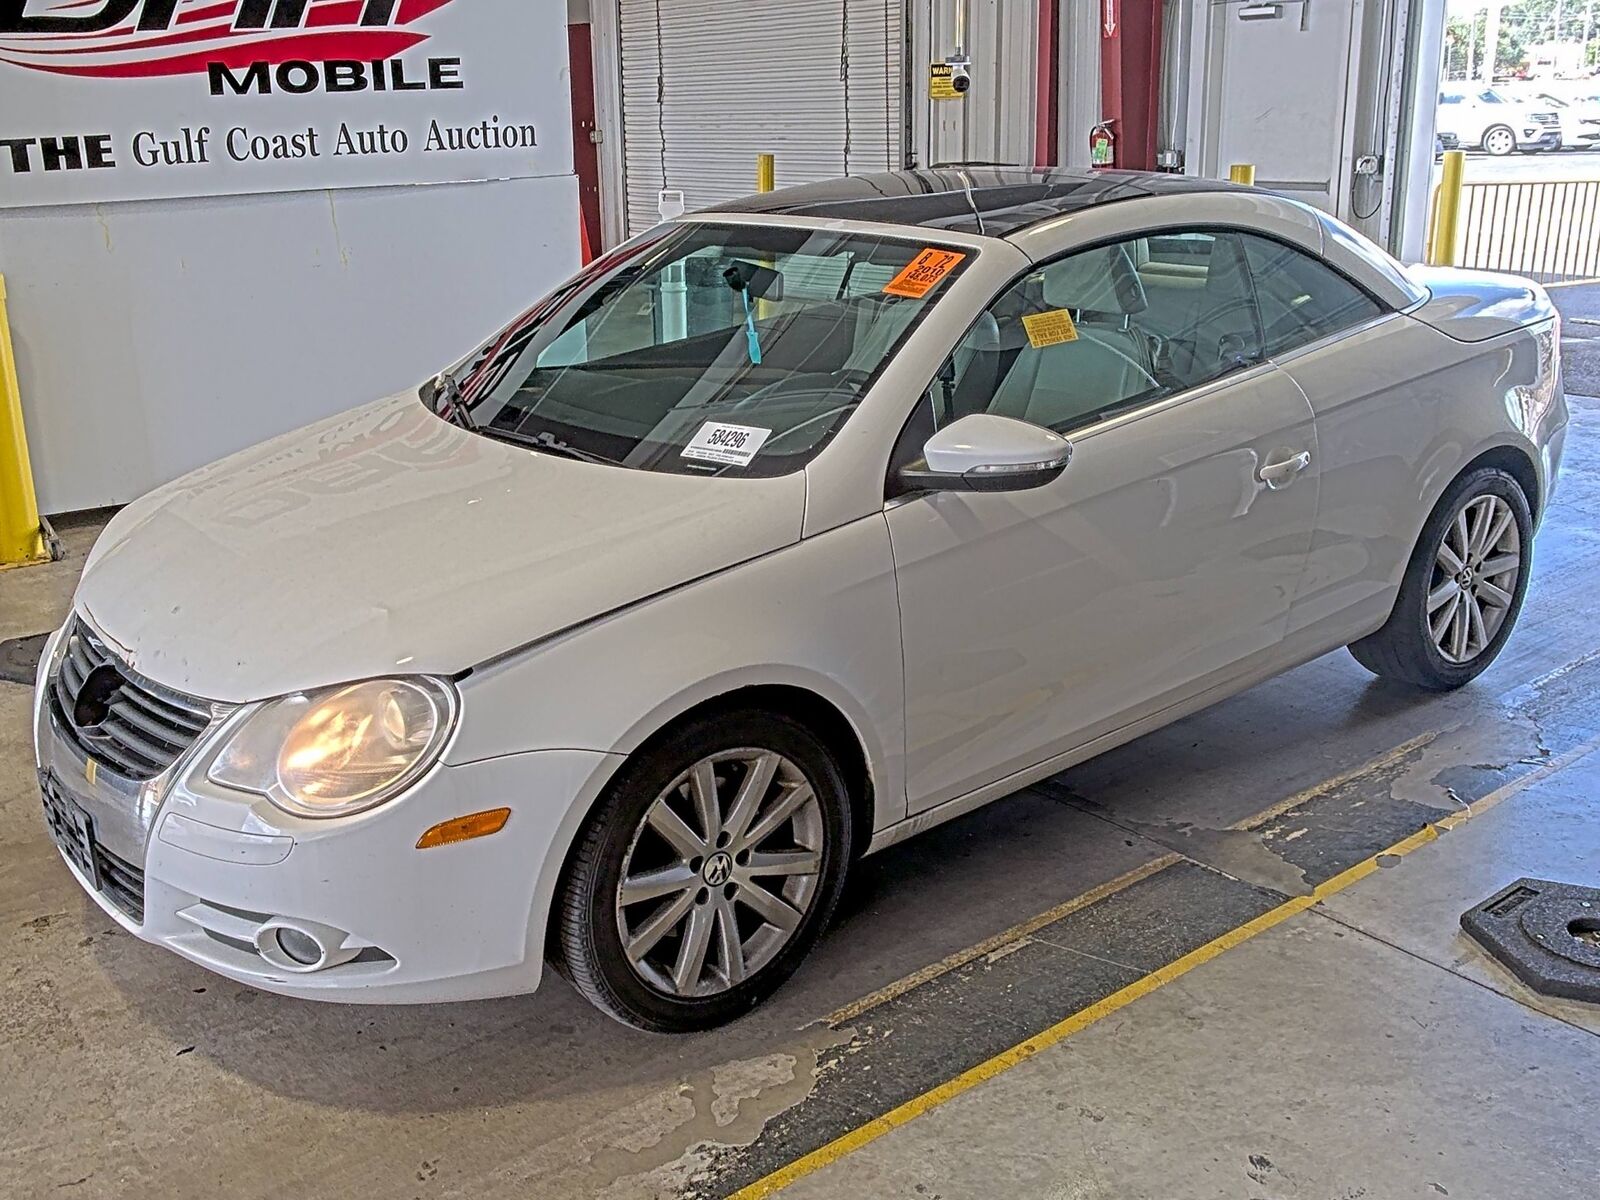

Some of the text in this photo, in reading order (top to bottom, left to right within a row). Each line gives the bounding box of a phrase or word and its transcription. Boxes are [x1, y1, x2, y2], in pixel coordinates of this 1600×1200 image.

[207, 57, 464, 96] MOBILE
[932, 67, 953, 75] WARN
[0, 115, 537, 173] THE Gulf Coast Auto Auction
[934, 254, 953, 268] 72
[914, 265, 945, 276] 2010
[707, 429, 749, 448] 584296
